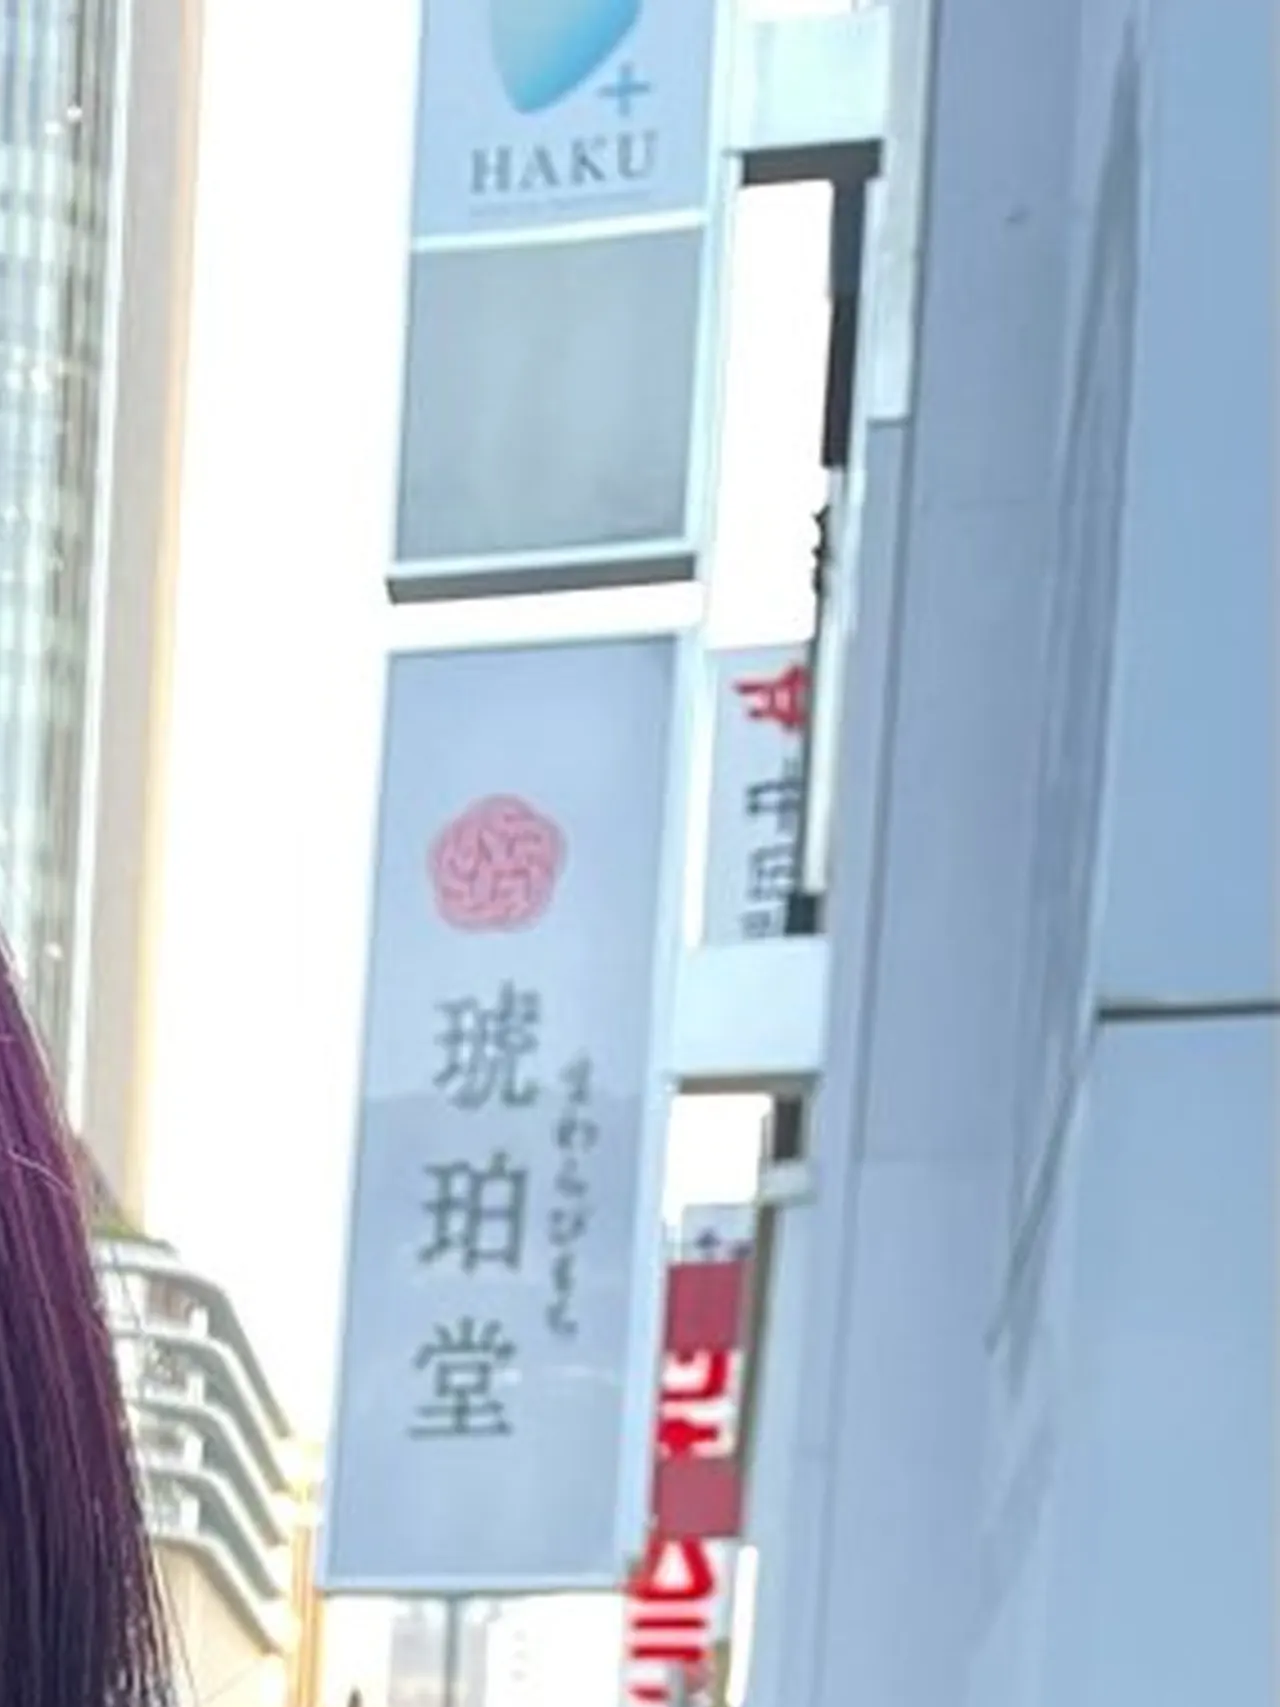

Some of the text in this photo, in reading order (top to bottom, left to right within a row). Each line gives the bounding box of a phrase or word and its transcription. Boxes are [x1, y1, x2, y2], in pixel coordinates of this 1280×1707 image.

[470, 128, 659, 195] HAKU
[408, 978, 541, 1440] 琥珀堂
